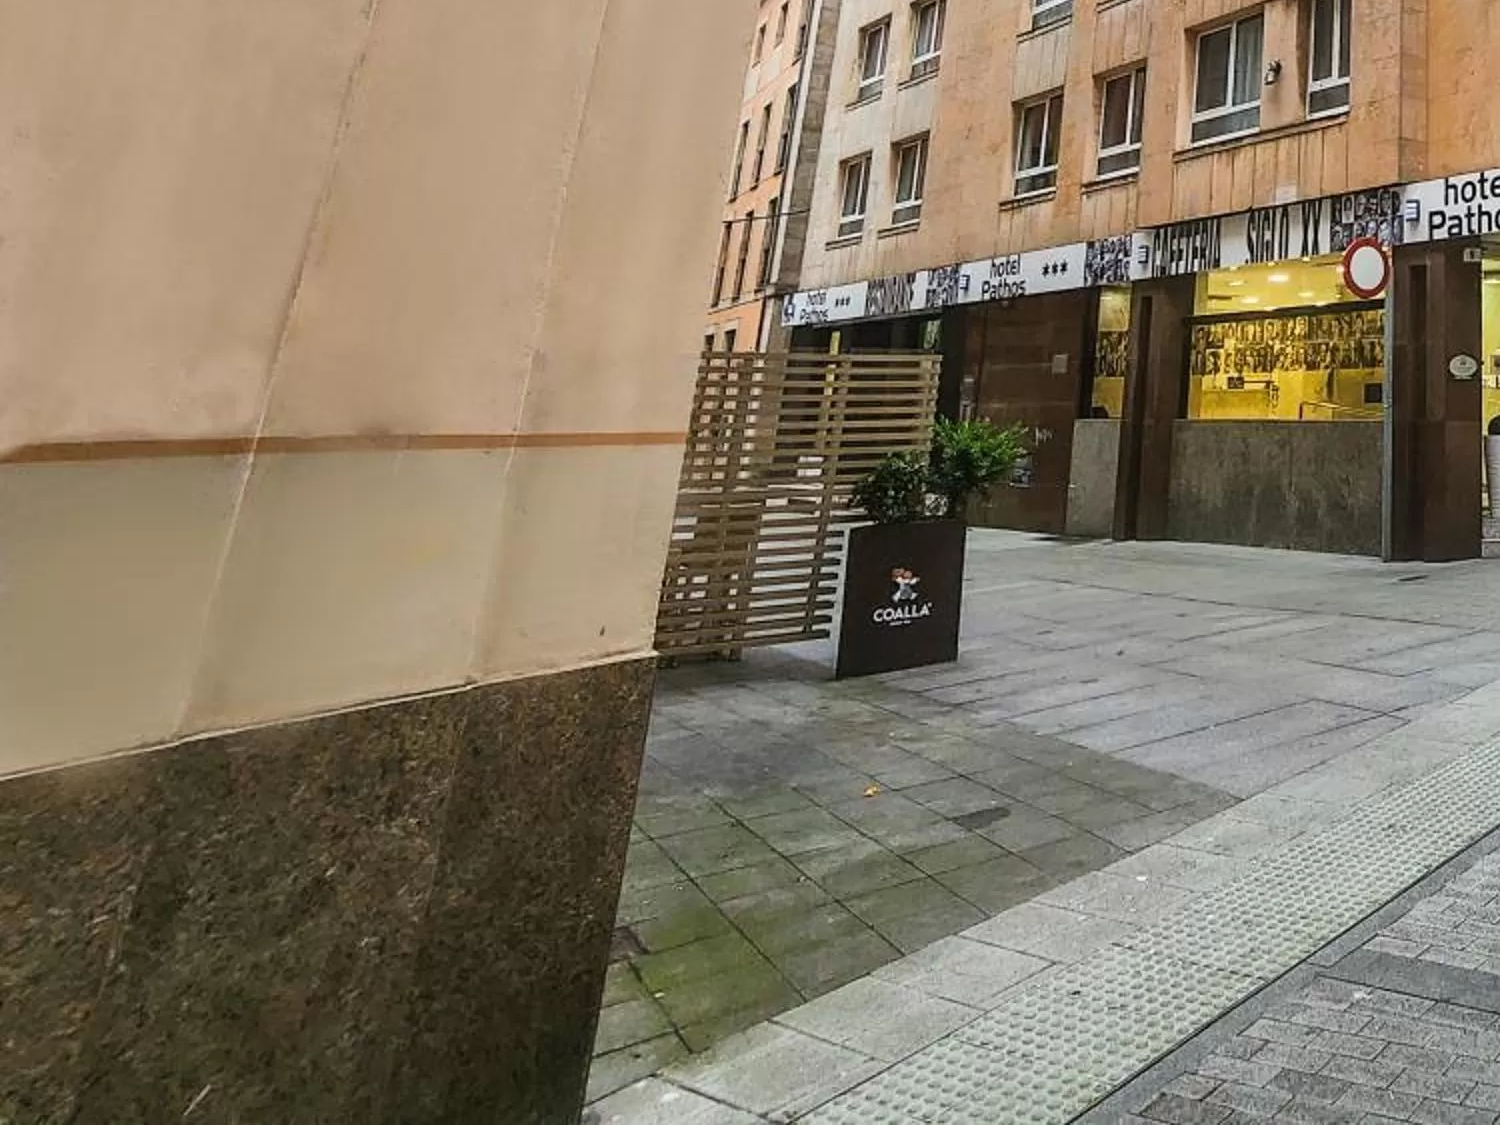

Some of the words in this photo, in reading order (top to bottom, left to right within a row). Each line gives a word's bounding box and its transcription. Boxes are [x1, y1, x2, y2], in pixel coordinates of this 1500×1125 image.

[1245, 205, 1289, 266] SIGLO
[1301, 198, 1323, 257] XX
[989, 253, 1021, 278] hotel
[981, 279, 1027, 302] Pathos
[873, 604, 930, 622] COALLA
